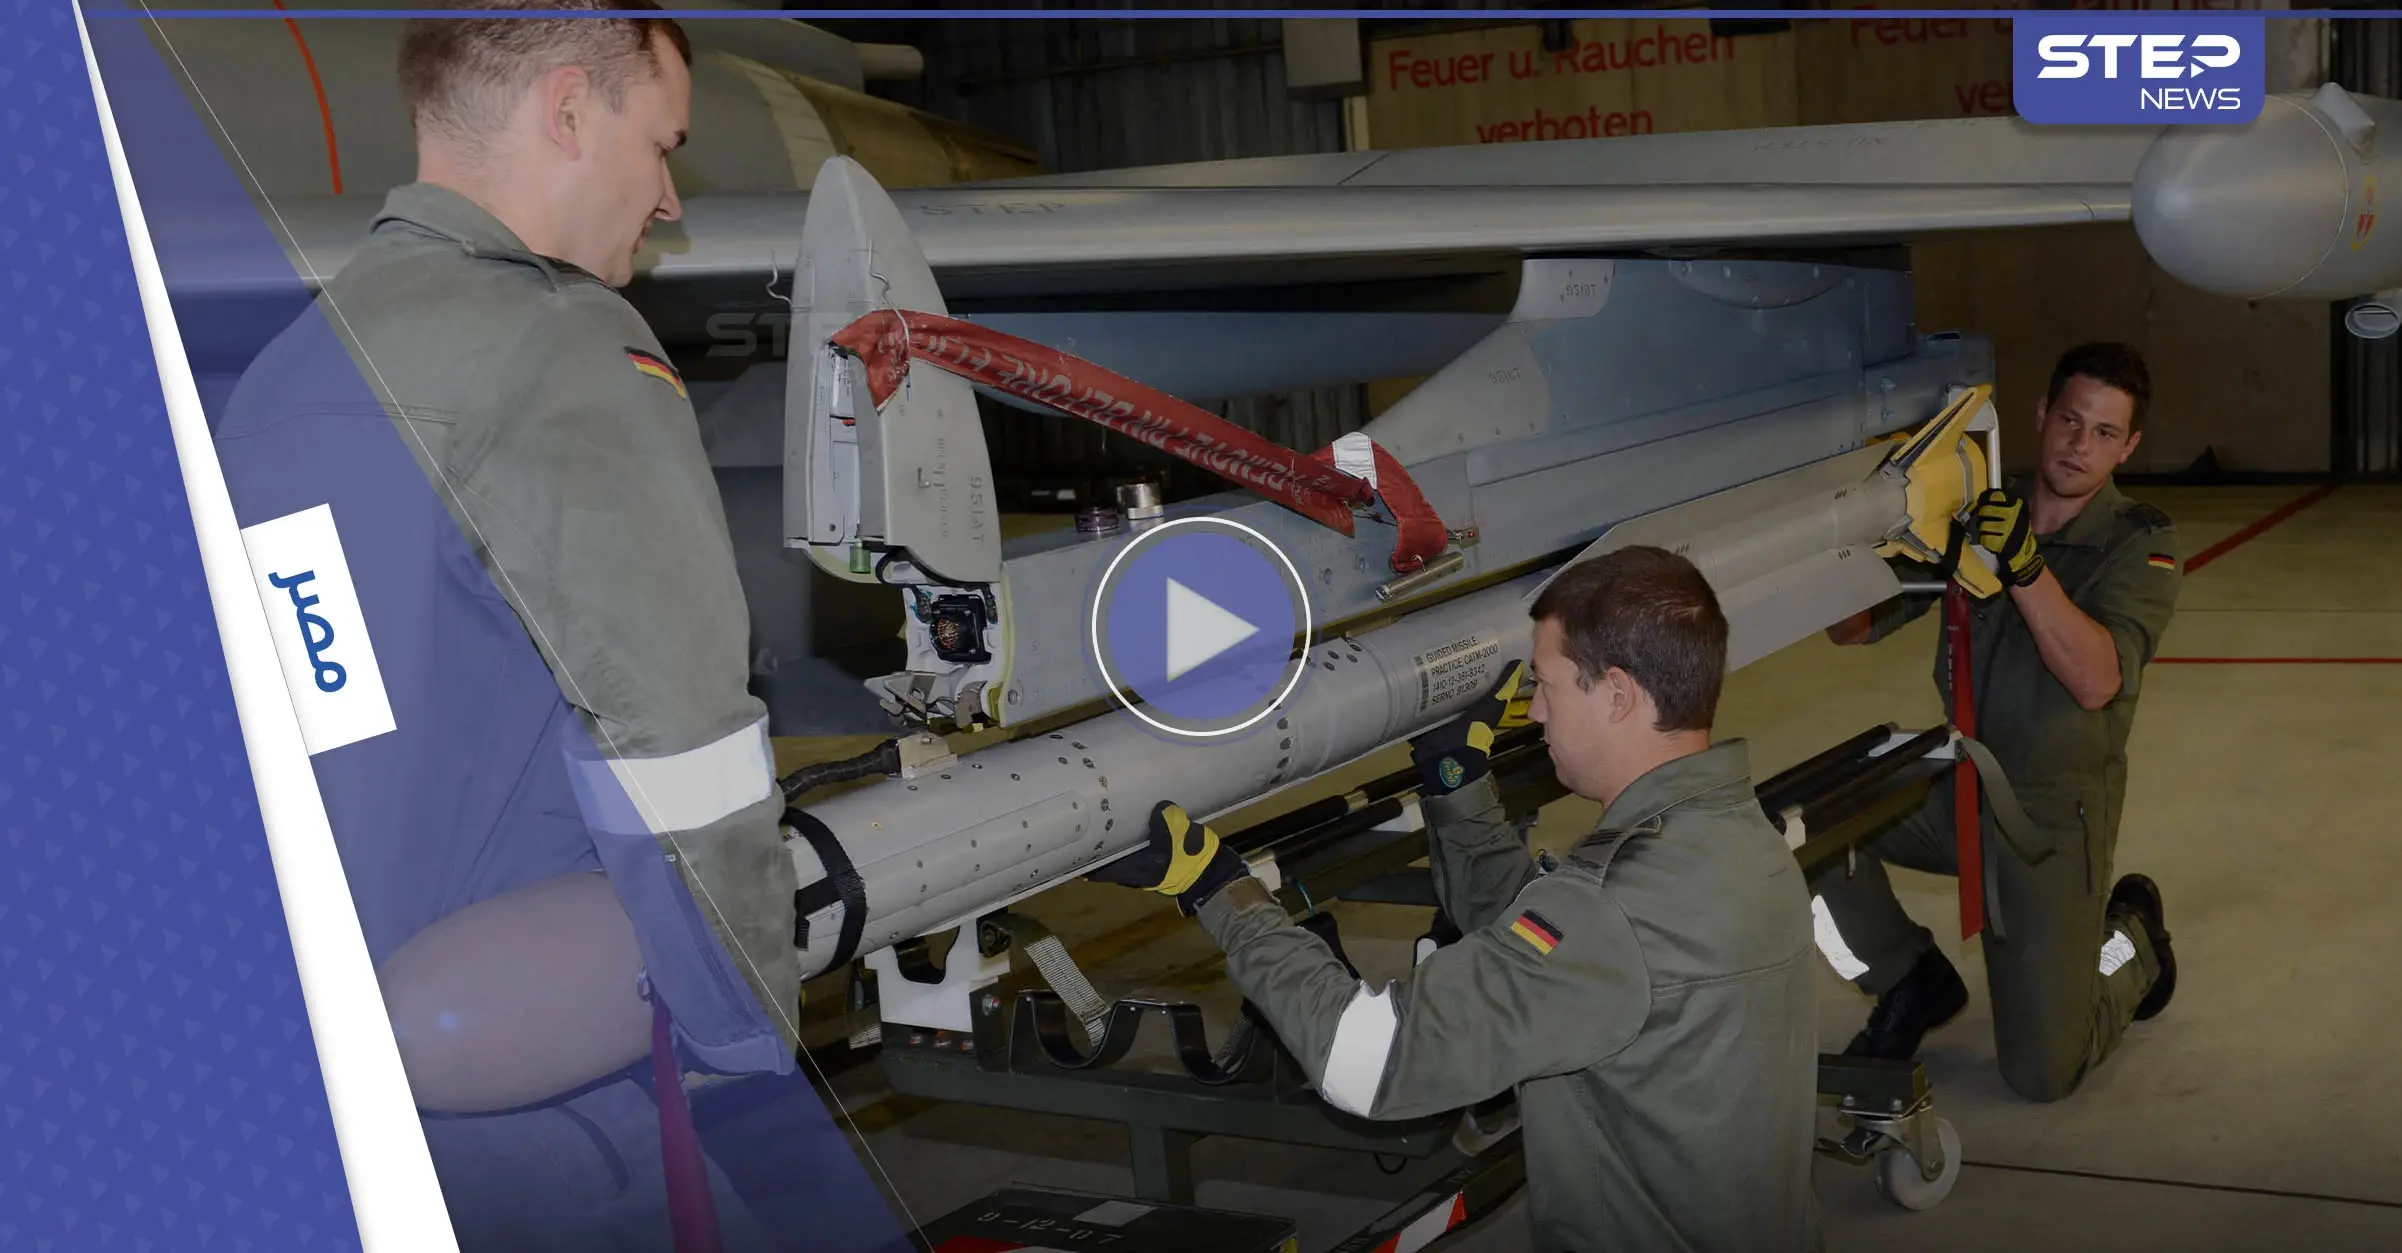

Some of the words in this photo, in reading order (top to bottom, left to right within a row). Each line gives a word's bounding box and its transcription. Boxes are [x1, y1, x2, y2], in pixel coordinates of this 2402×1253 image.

[1388, 48, 1495, 91] Feuer
[1508, 48, 1541, 79] u.
[1475, 103, 1654, 144] verboten
[919, 201, 1066, 217] STEP
[1425, 646, 1453, 663] GUIDED
[1451, 636, 1480, 653] MISSILE
[1430, 657, 1463, 678] PRACTICE
[1463, 644, 1499, 665] CATM-2000
